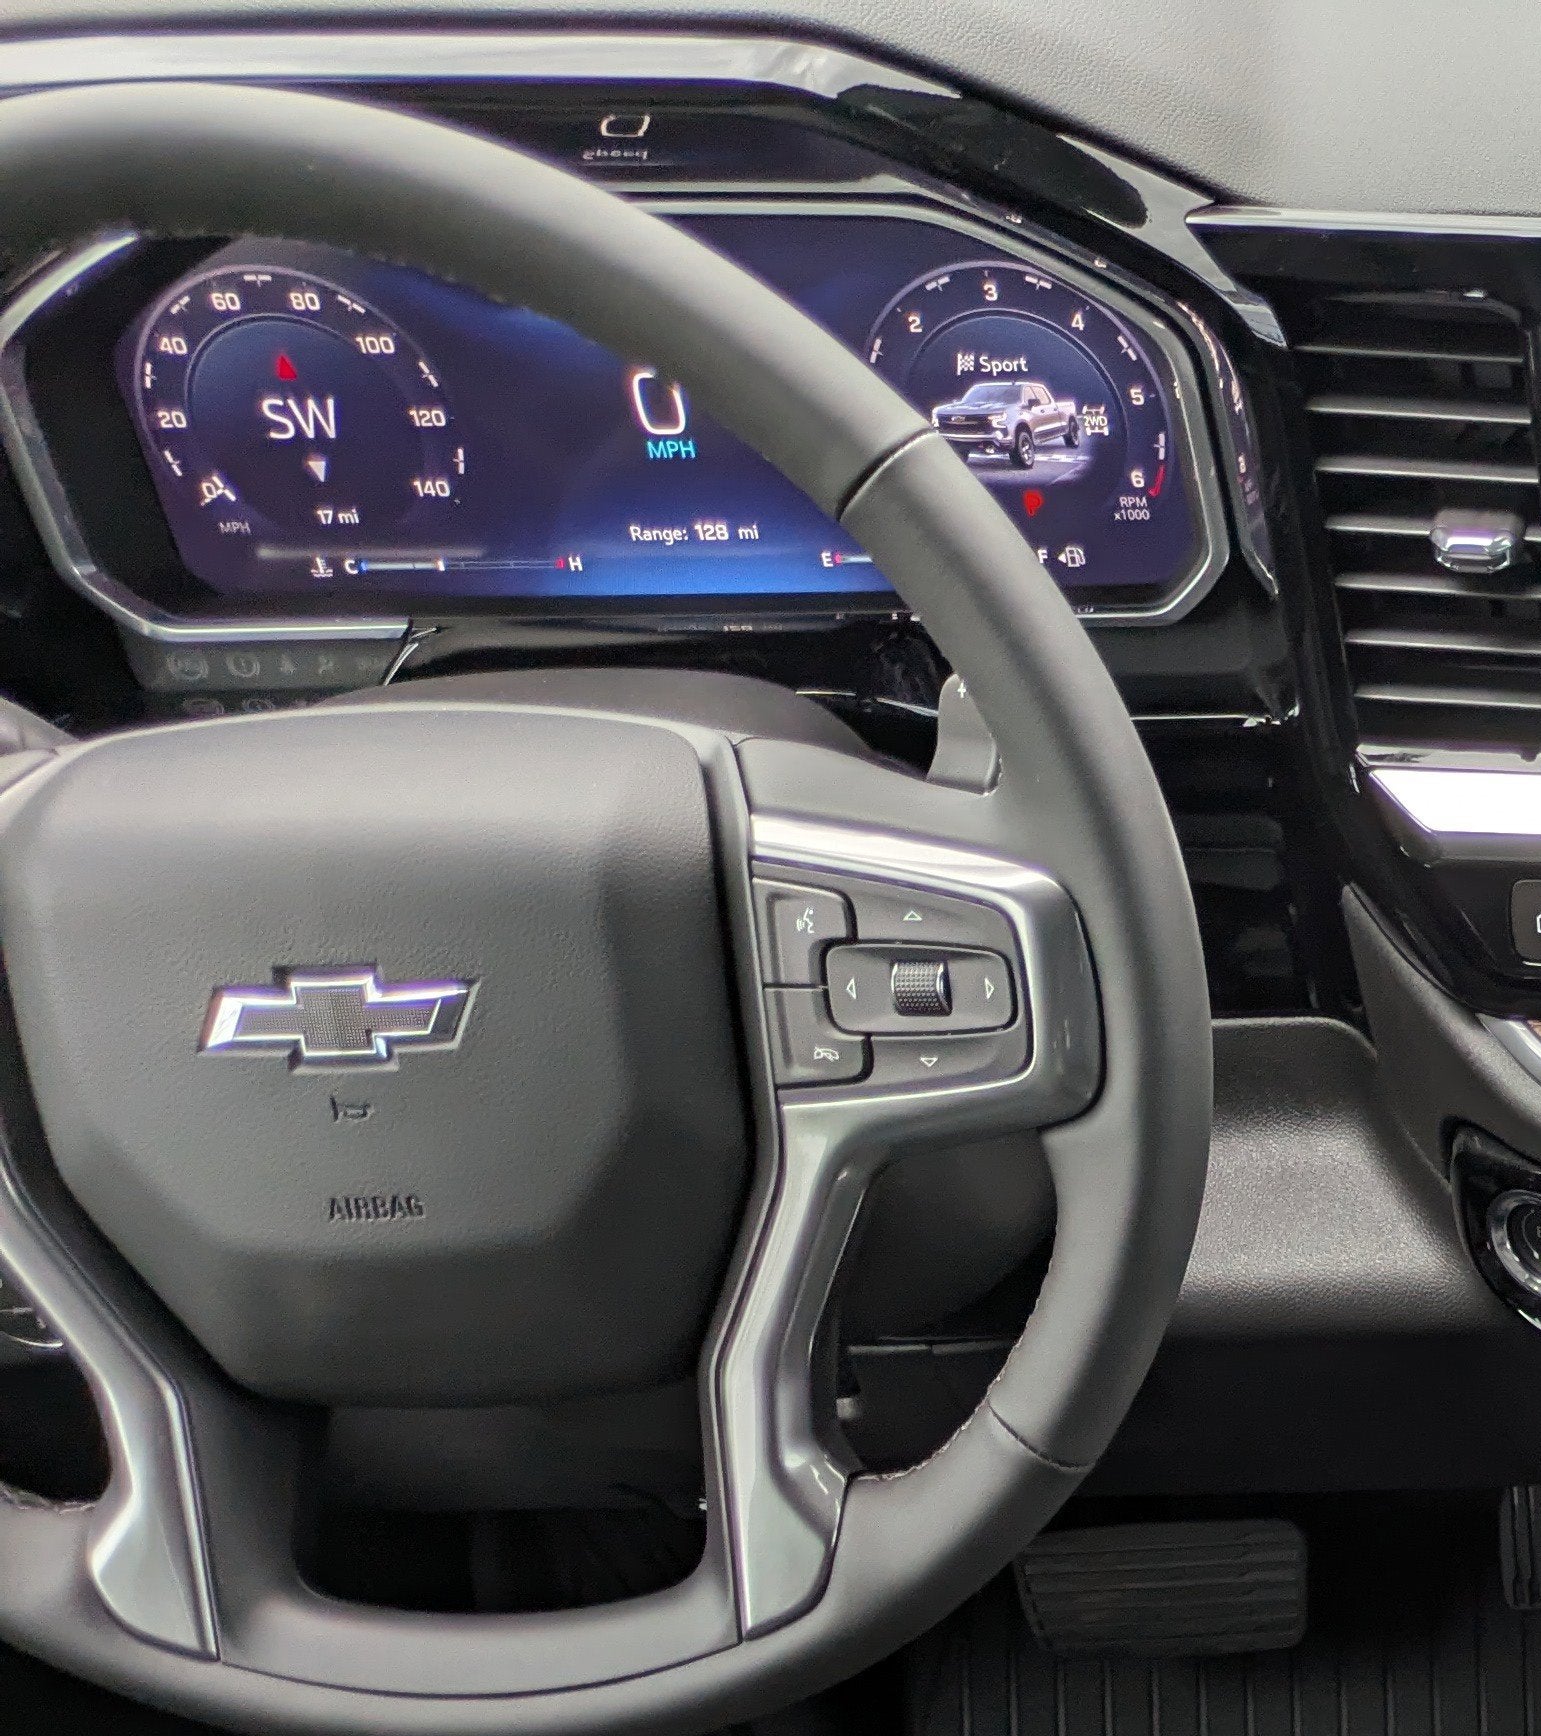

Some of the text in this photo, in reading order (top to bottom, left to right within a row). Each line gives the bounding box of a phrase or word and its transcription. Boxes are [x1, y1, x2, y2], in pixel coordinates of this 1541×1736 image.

[984, 284, 998, 301] 3
[211, 293, 241, 312] 60
[290, 293, 321, 312] 80
[908, 316, 923, 333] 2
[1071, 314, 1085, 331] 4
[158, 337, 187, 355] 40
[355, 336, 395, 354] 100
[980, 354, 1028, 376] Sport
[632, 371, 686, 435] 0
[1131, 389, 1145, 406] 5
[157, 411, 187, 429] 20
[261, 398, 337, 439] SW
[409, 410, 446, 427] 120
[1084, 416, 1107, 427] 2WD
[647, 441, 696, 459] MPH
[1131, 471, 1145, 488] 6
[413, 480, 450, 497] 140
[1119, 497, 1147, 508] RPM
[317, 509, 360, 524] 17 mi
[1114, 510, 1149, 521] x1000
[219, 521, 251, 535] MPH
[630, 524, 759, 545] Range: 128 mi
[568, 557, 583, 572] H
[821, 552, 833, 567] E
[1037, 550, 1048, 563] F
[344, 559, 359, 575] C
[328, 1196, 423, 1221] AIRBAG
